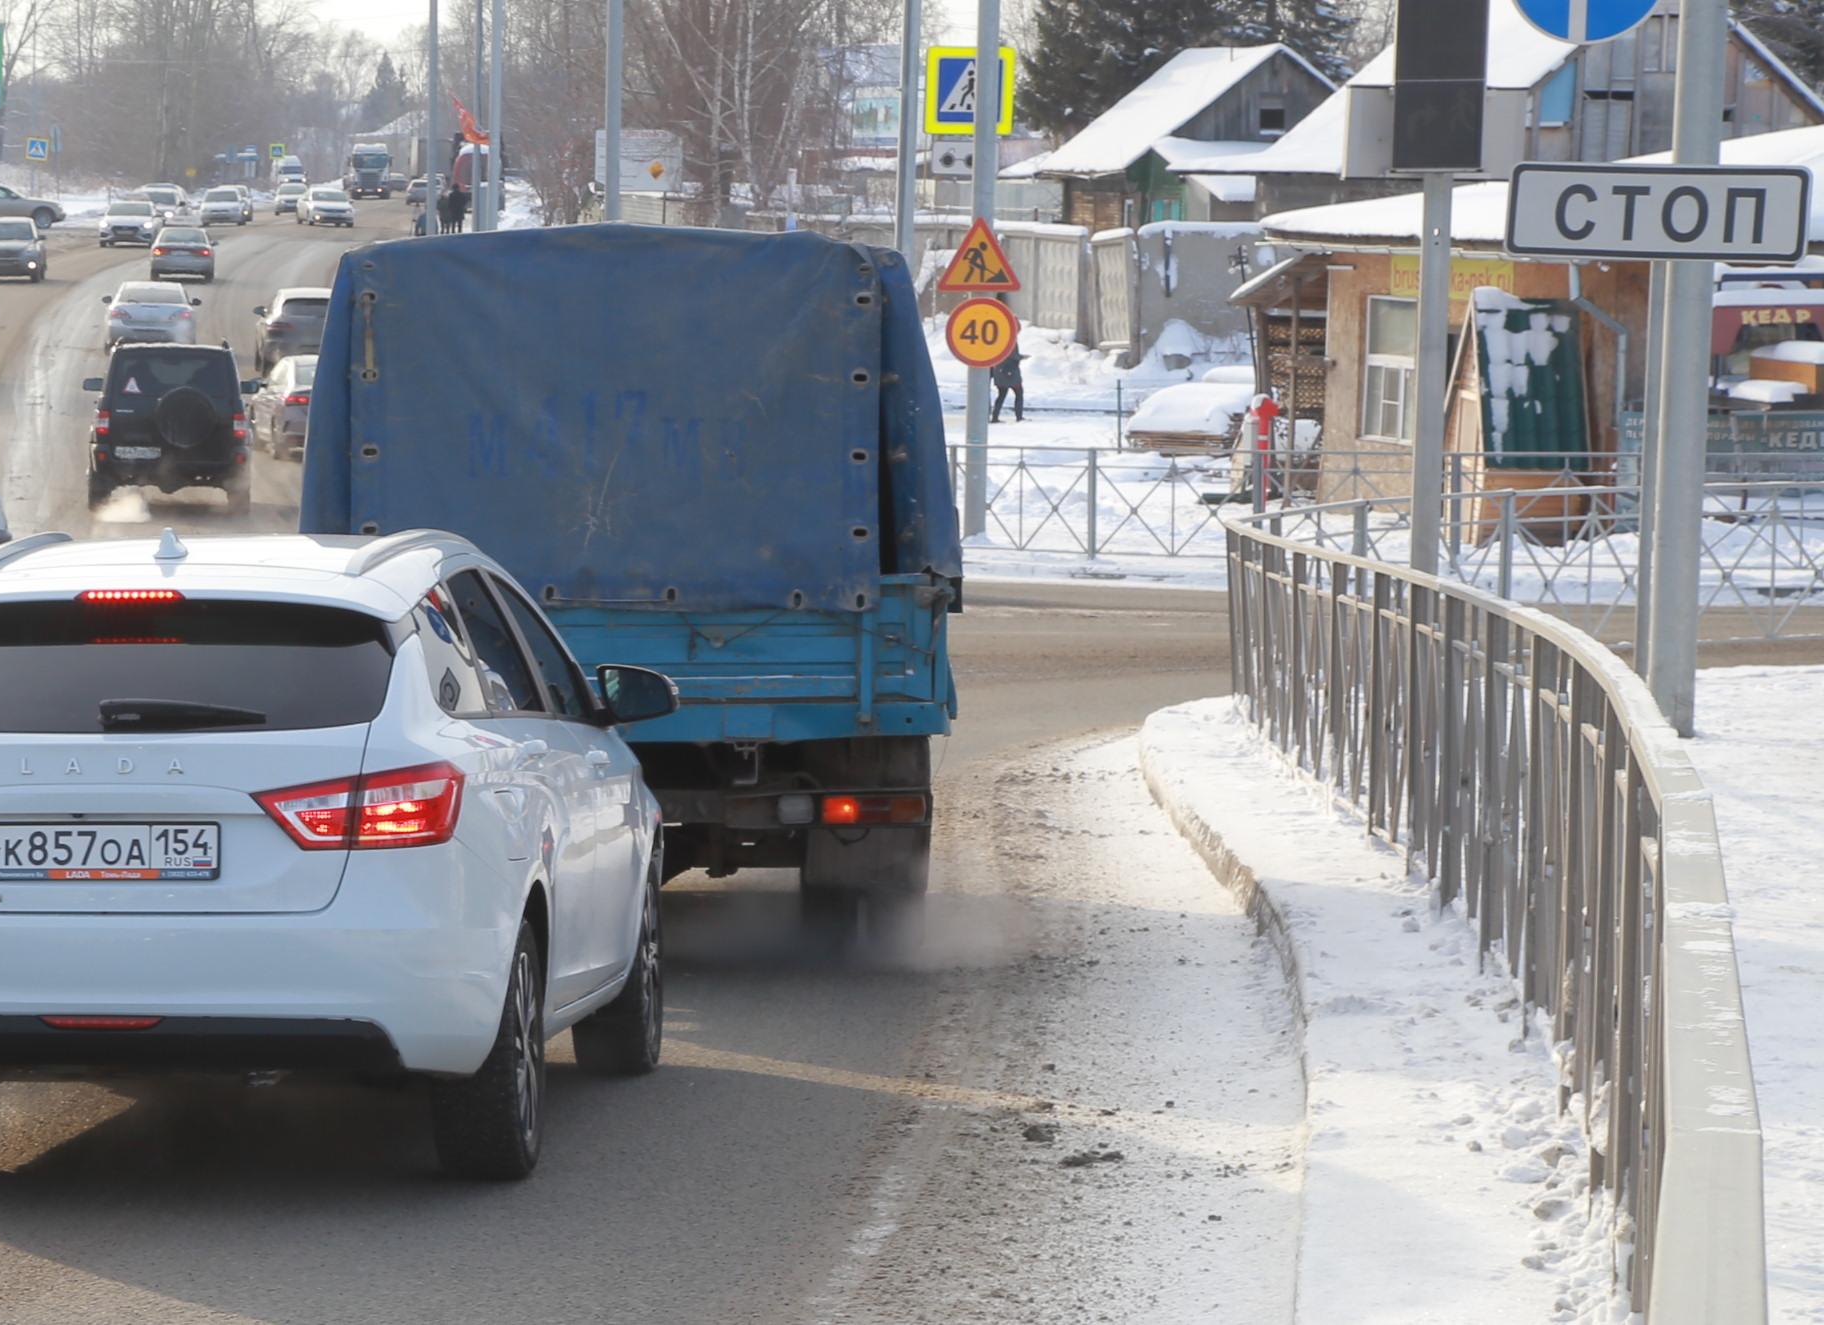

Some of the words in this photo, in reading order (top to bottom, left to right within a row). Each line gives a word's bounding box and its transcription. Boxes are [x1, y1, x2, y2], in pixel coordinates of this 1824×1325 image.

[1555, 184, 1767, 244] СТОП
[1741, 308, 1811, 325] КЕДР
[960, 319, 999, 345] 40
[21, 757, 184, 775] LADA
[155, 828, 209, 856] 154
[164, 857, 191, 867] RUS
